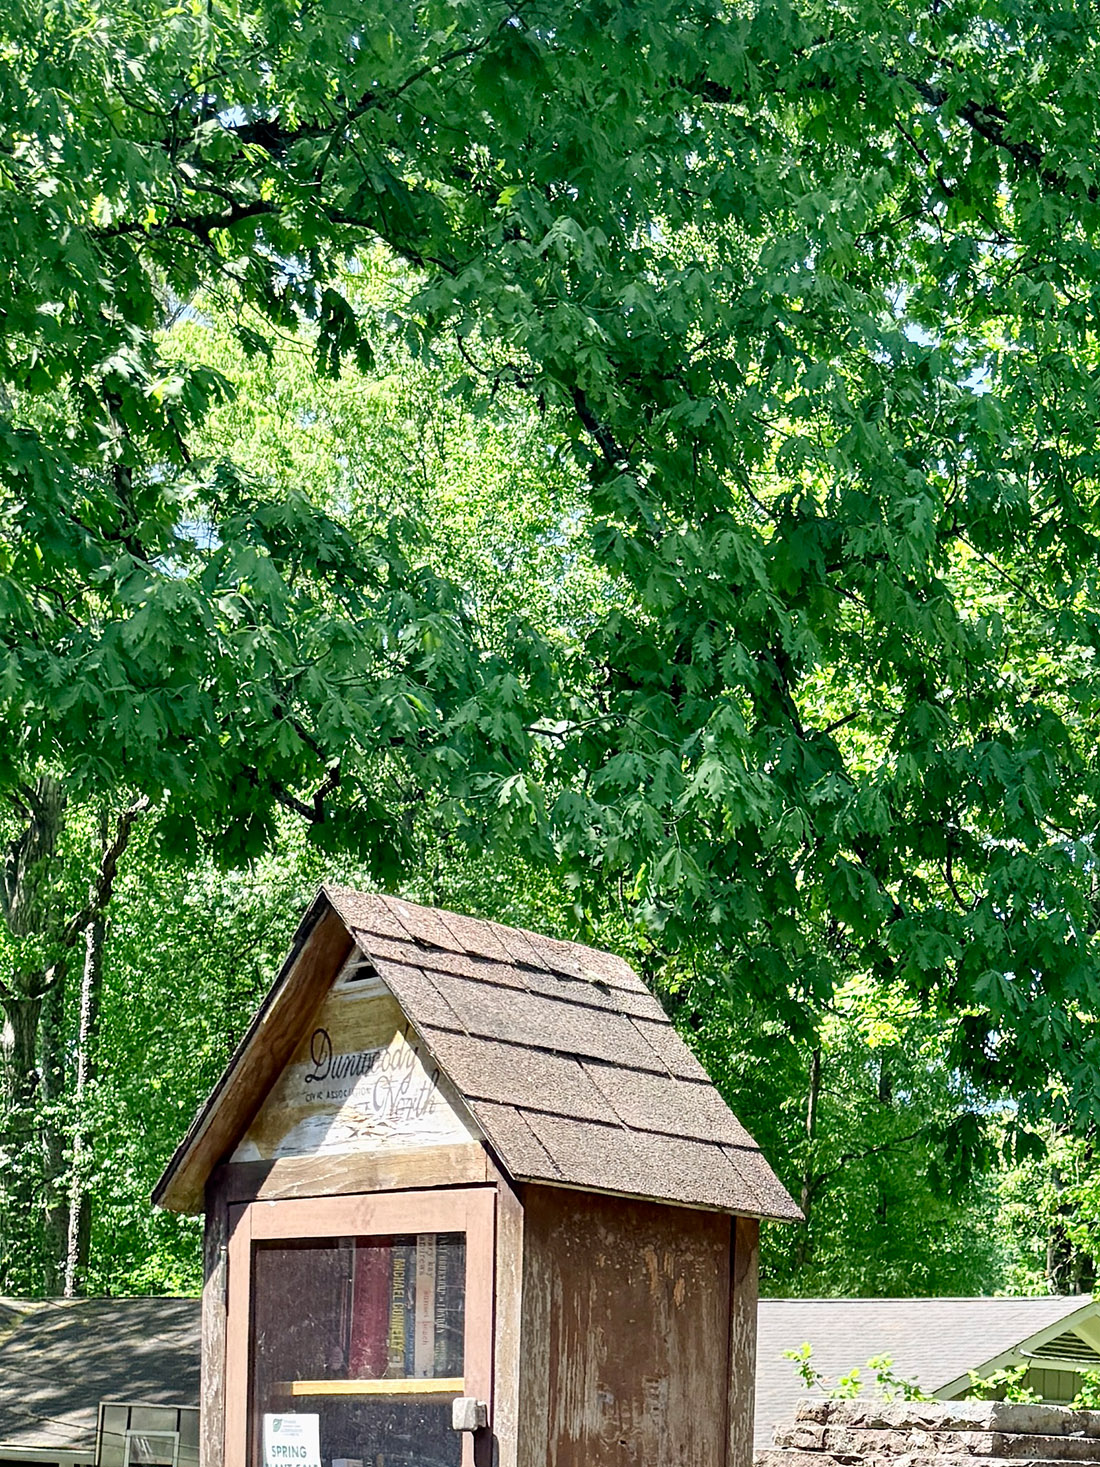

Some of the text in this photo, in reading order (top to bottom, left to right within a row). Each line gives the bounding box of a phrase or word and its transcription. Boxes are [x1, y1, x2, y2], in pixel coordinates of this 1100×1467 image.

[305, 1022, 418, 1094] Dunwoody
[373, 1068, 440, 1118] North
[392, 1258, 406, 1300] MICHAEL
[390, 1302, 406, 1351] CONNELLY
[271, 1445, 307, 1458] SPRING
